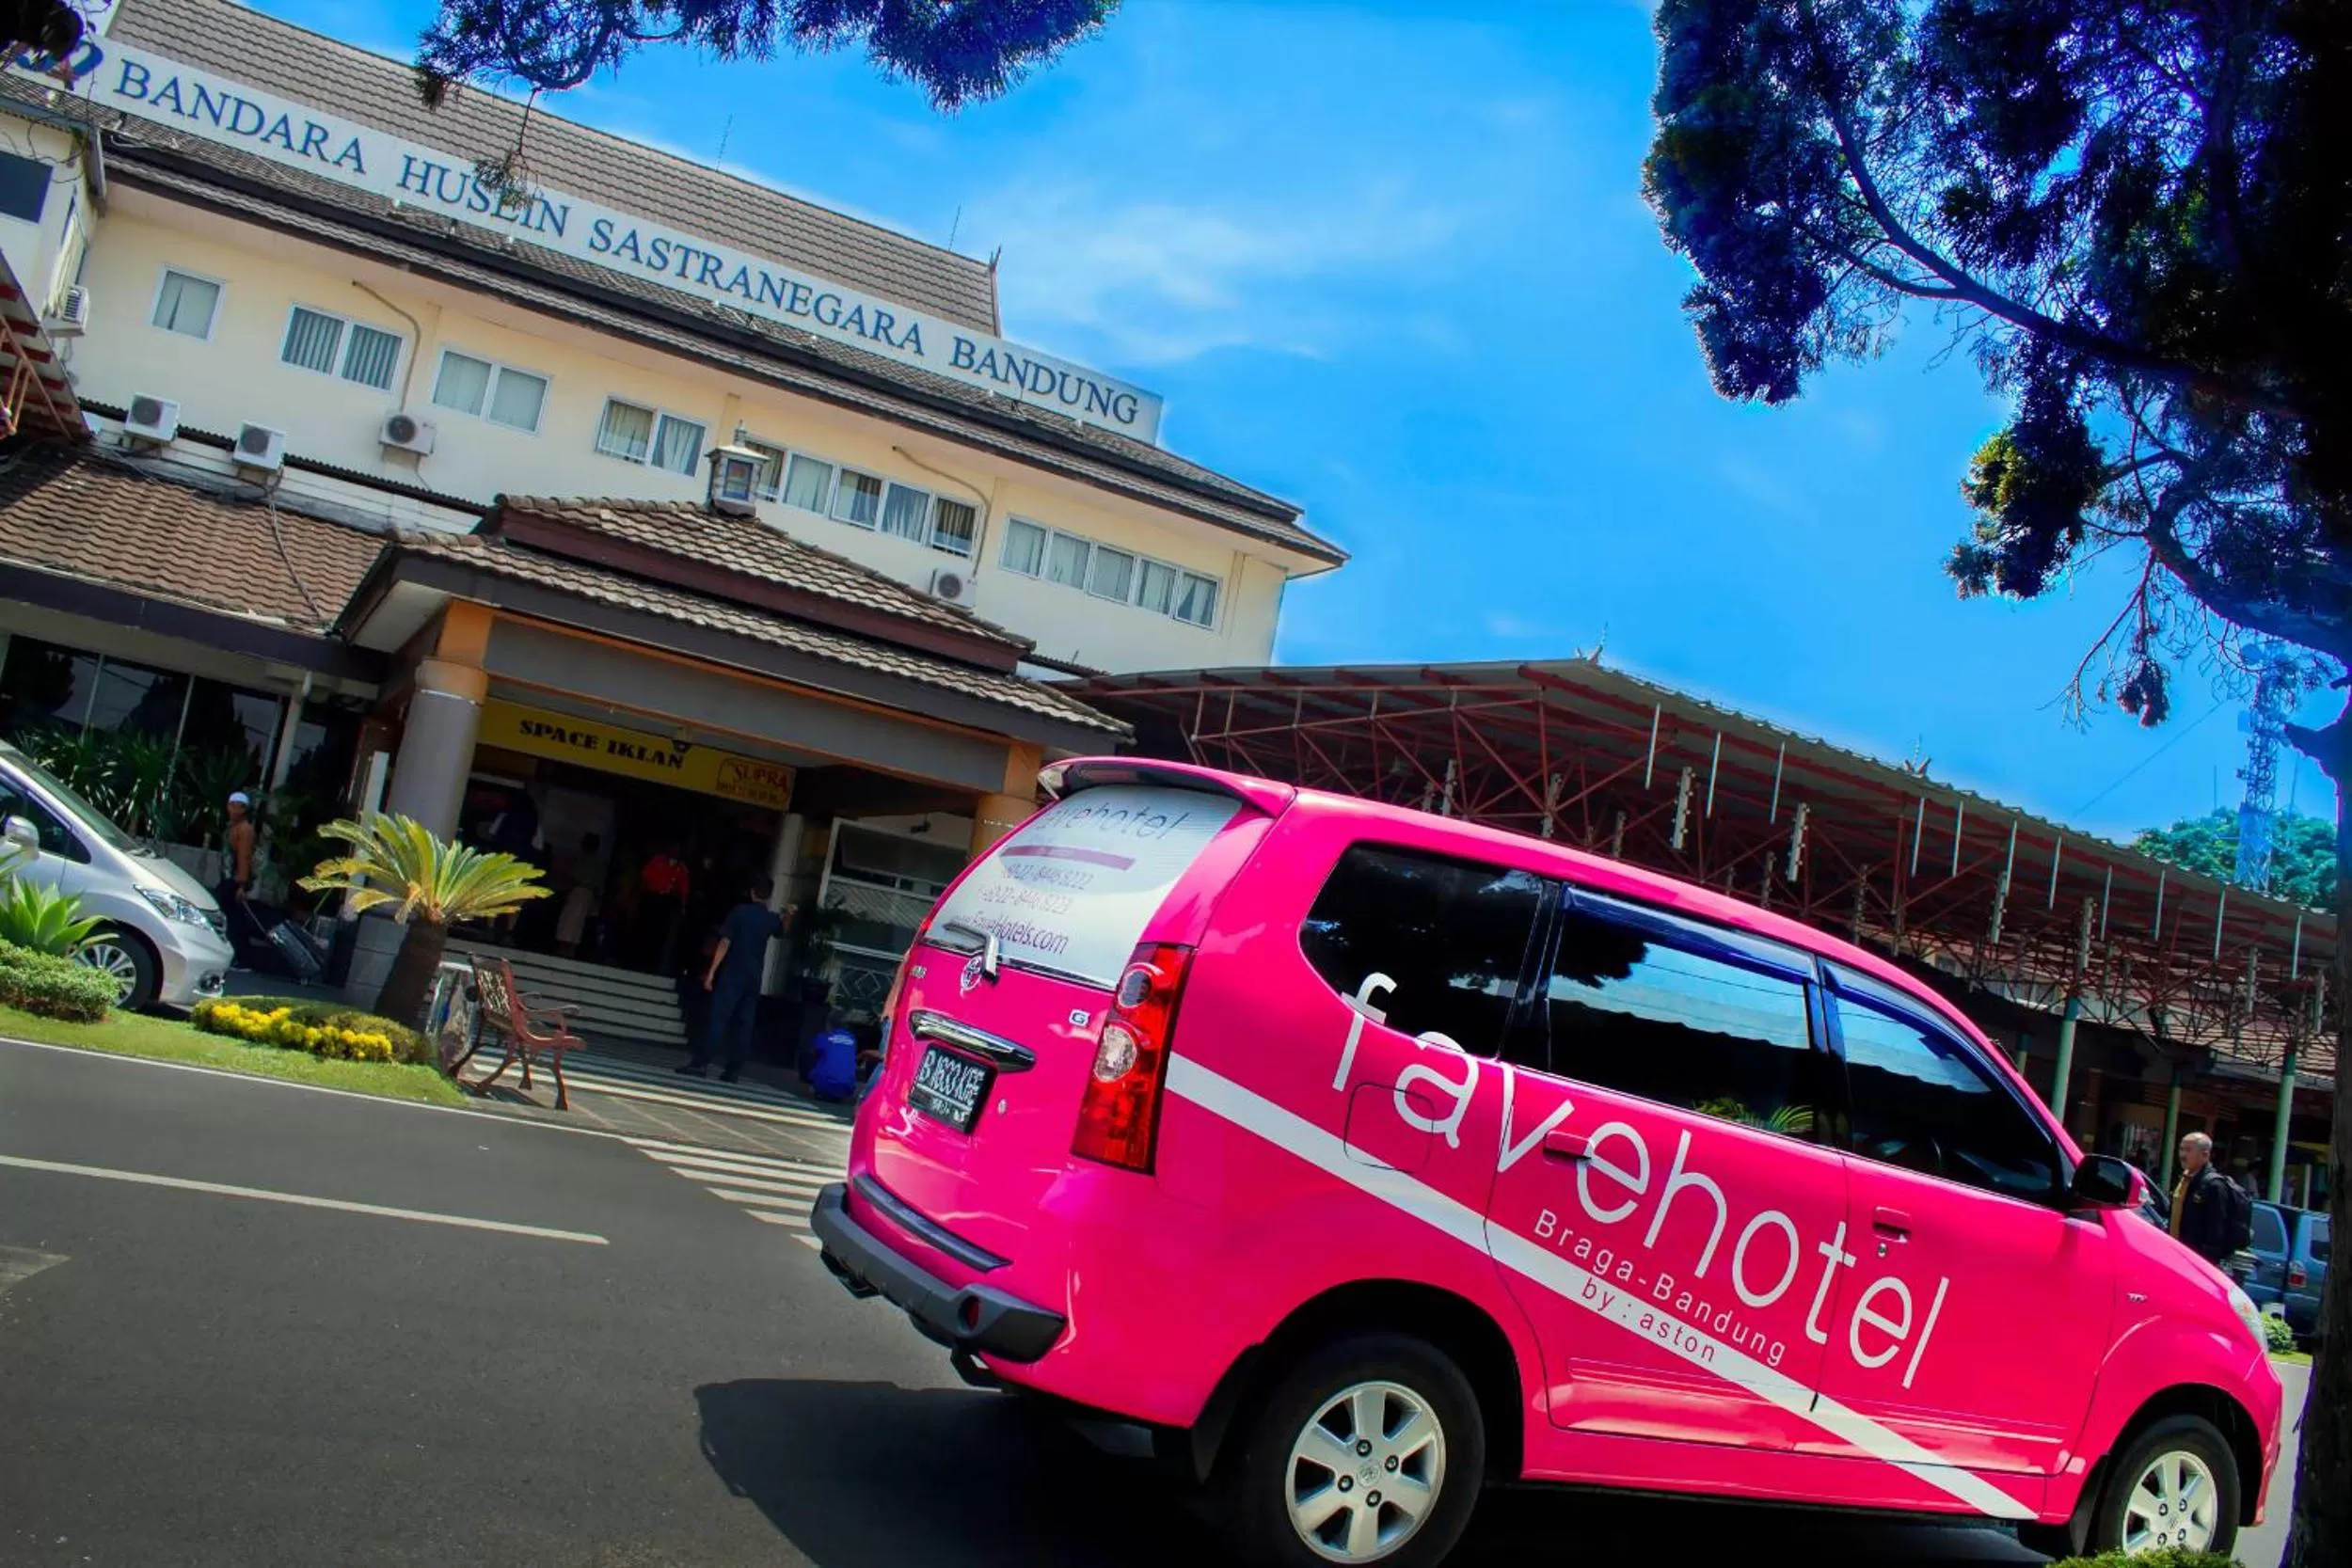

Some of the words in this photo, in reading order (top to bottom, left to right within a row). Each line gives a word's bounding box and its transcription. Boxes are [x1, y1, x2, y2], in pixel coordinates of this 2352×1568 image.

[112, 57, 367, 175] BANDARA
[395, 154, 572, 239] HUSEIN
[588, 217, 926, 356] SASTRANEGARA
[947, 336, 1139, 425] BANDUNG
[518, 718, 598, 751] SPACE
[607, 738, 684, 770] IKLAN
[1332, 973, 1950, 1389] favehotel
[1533, 1208, 1787, 1367] Braga-Bandung
[1581, 1277, 1616, 1312] by
[1639, 1311, 1716, 1364] aston
